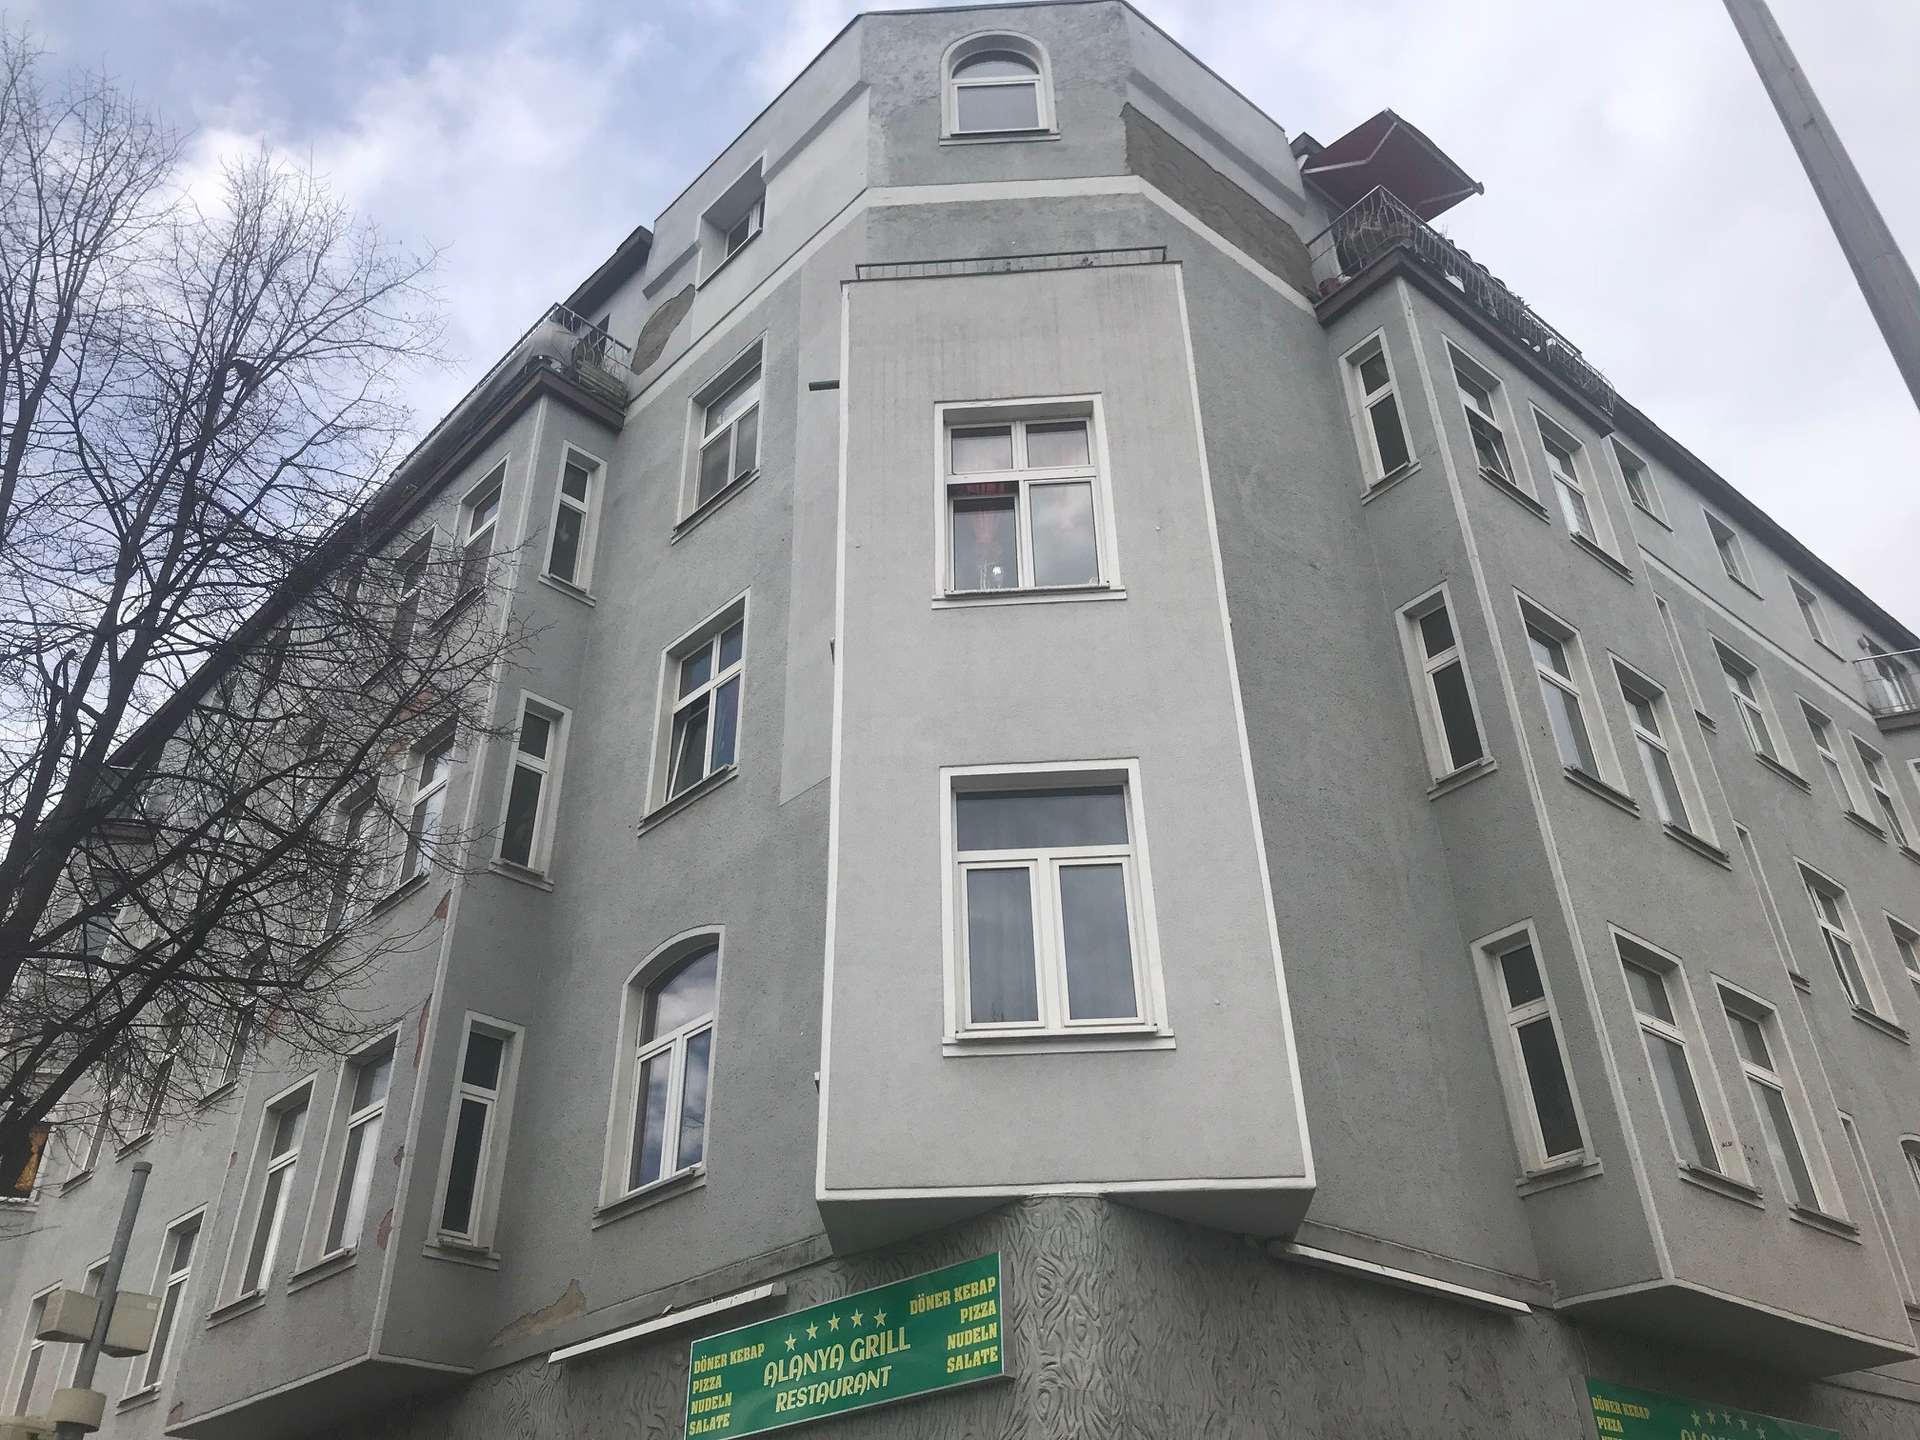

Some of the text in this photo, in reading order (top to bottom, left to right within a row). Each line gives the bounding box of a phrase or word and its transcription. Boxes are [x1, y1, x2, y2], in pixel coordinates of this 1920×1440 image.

[910, 1276, 996, 1314] DÖNER KEBAP
[960, 1299, 997, 1323] PIZZA
[947, 1321, 998, 1351] NUDELN
[693, 1344, 765, 1375] DÖNER KEBAP
[763, 1326, 911, 1388] ALANYA GRILL
[946, 1346, 999, 1373] SALATE
[692, 1374, 722, 1394] PIZZA
[775, 1366, 892, 1413] RESTAURANT
[690, 1391, 732, 1415] NUDELN
[688, 1412, 731, 1435] SALATE
[1596, 1416, 1624, 1433] PIZZA
